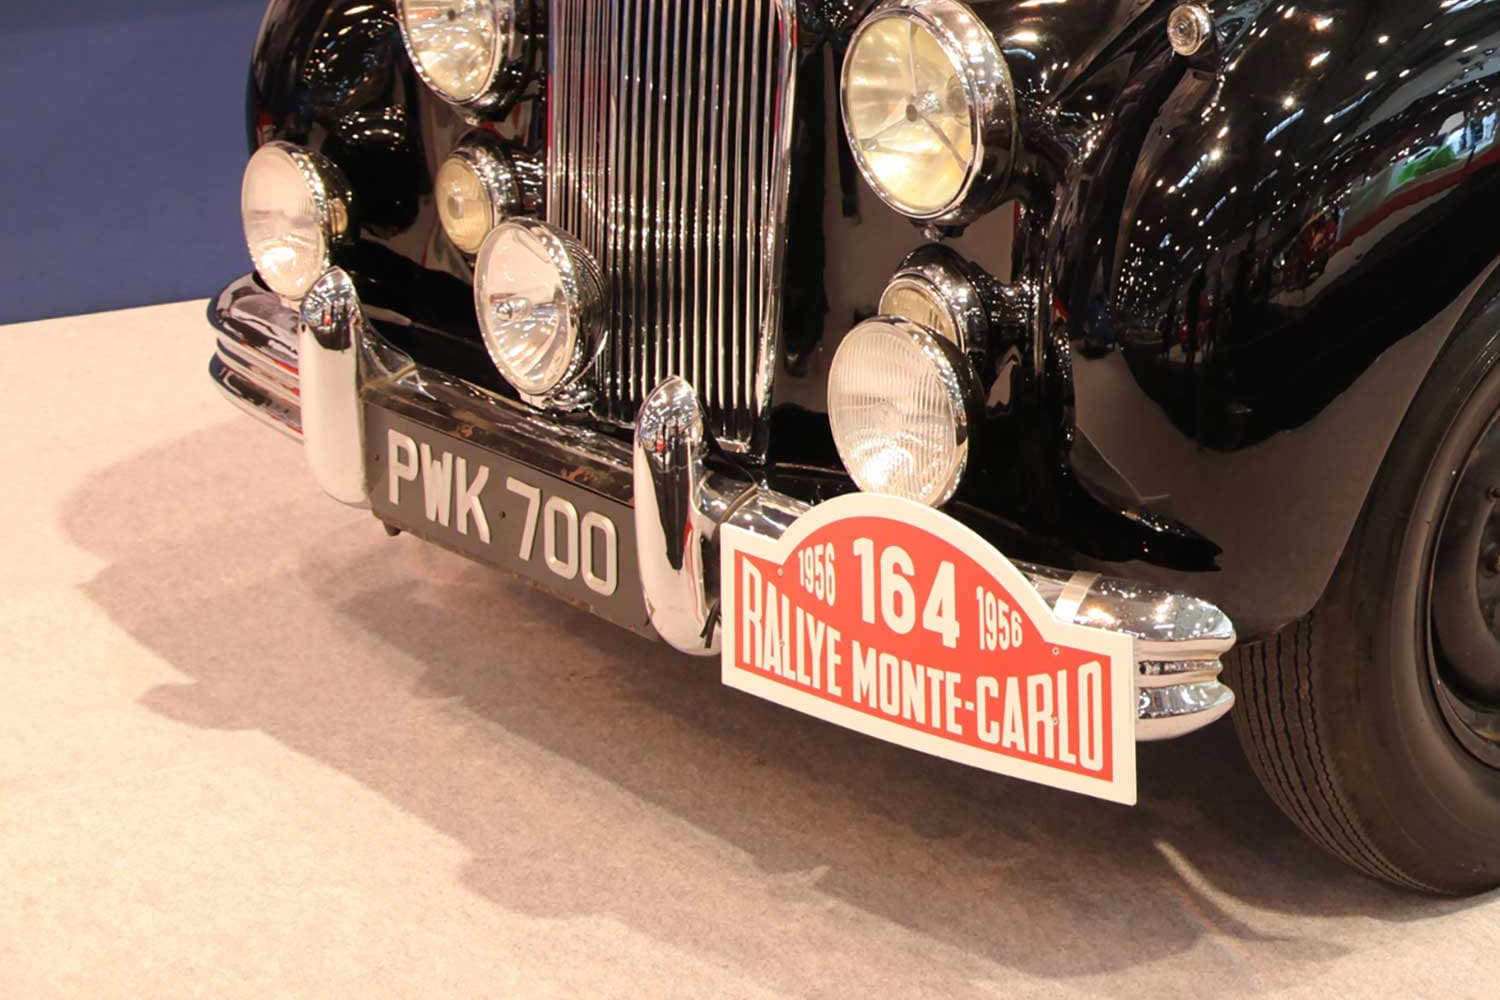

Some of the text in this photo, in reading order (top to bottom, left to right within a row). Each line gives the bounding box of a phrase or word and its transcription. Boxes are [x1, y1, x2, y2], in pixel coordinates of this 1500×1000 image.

[387, 428, 618, 597] PWK 700
[797, 536, 1023, 651] 1956 164 1956
[741, 555, 1103, 772] RALLYE MONTE-CARLO
